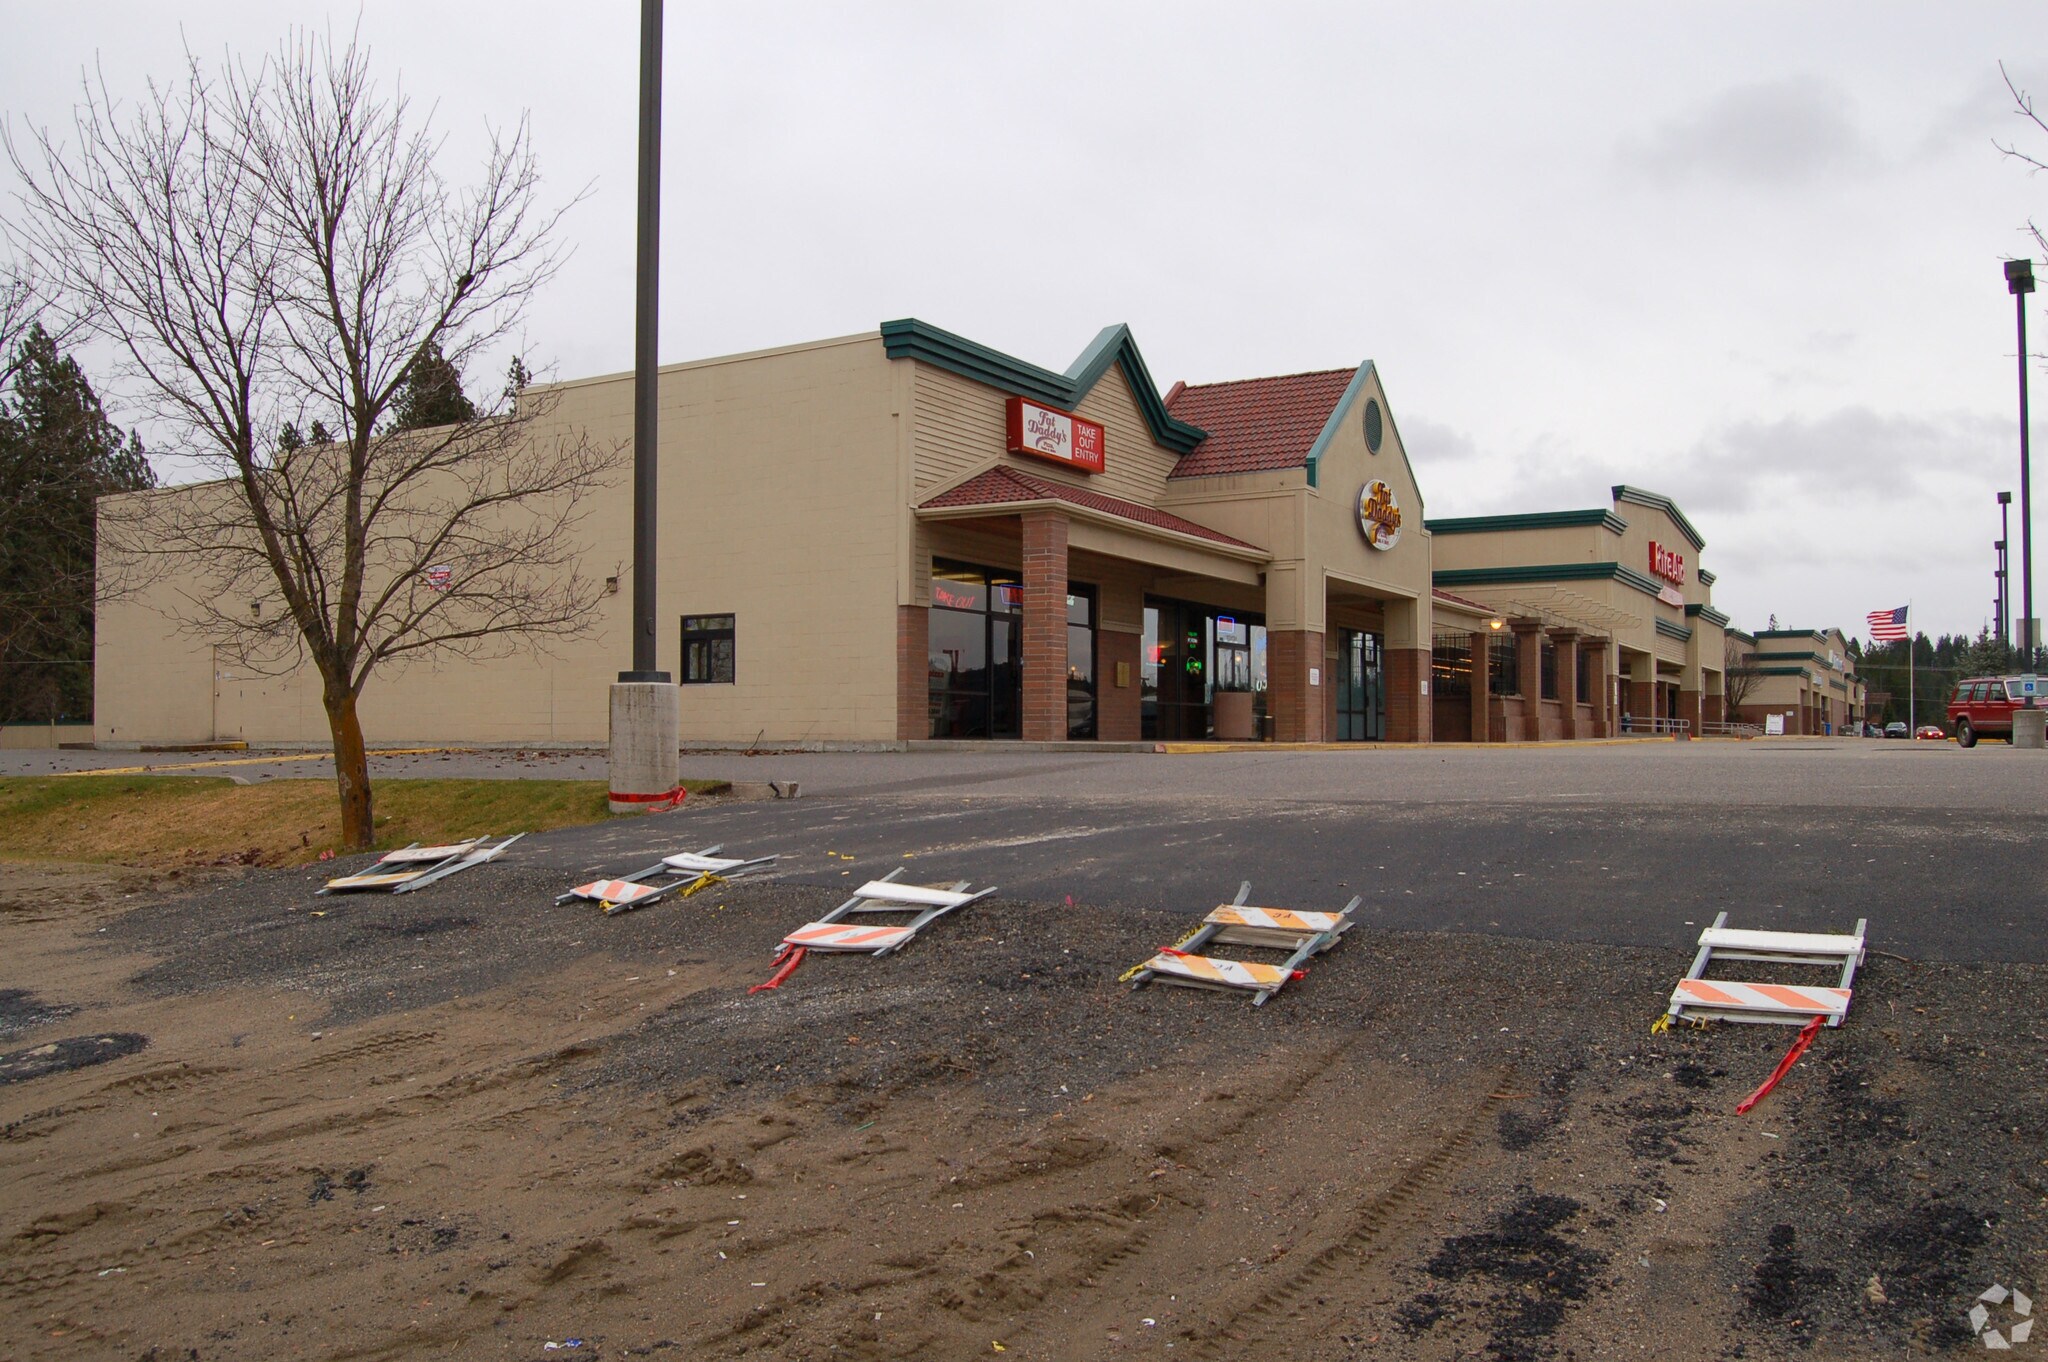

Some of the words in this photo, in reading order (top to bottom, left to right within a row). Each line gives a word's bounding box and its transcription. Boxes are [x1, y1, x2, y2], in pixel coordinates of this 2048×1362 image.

[1039, 411, 1055, 427] Fat
[1028, 419, 1067, 443] Daddy's
[1077, 424, 1096, 439] TAKE
[1079, 437, 1094, 449] OUT
[1075, 447, 1098, 463] ENTRY
